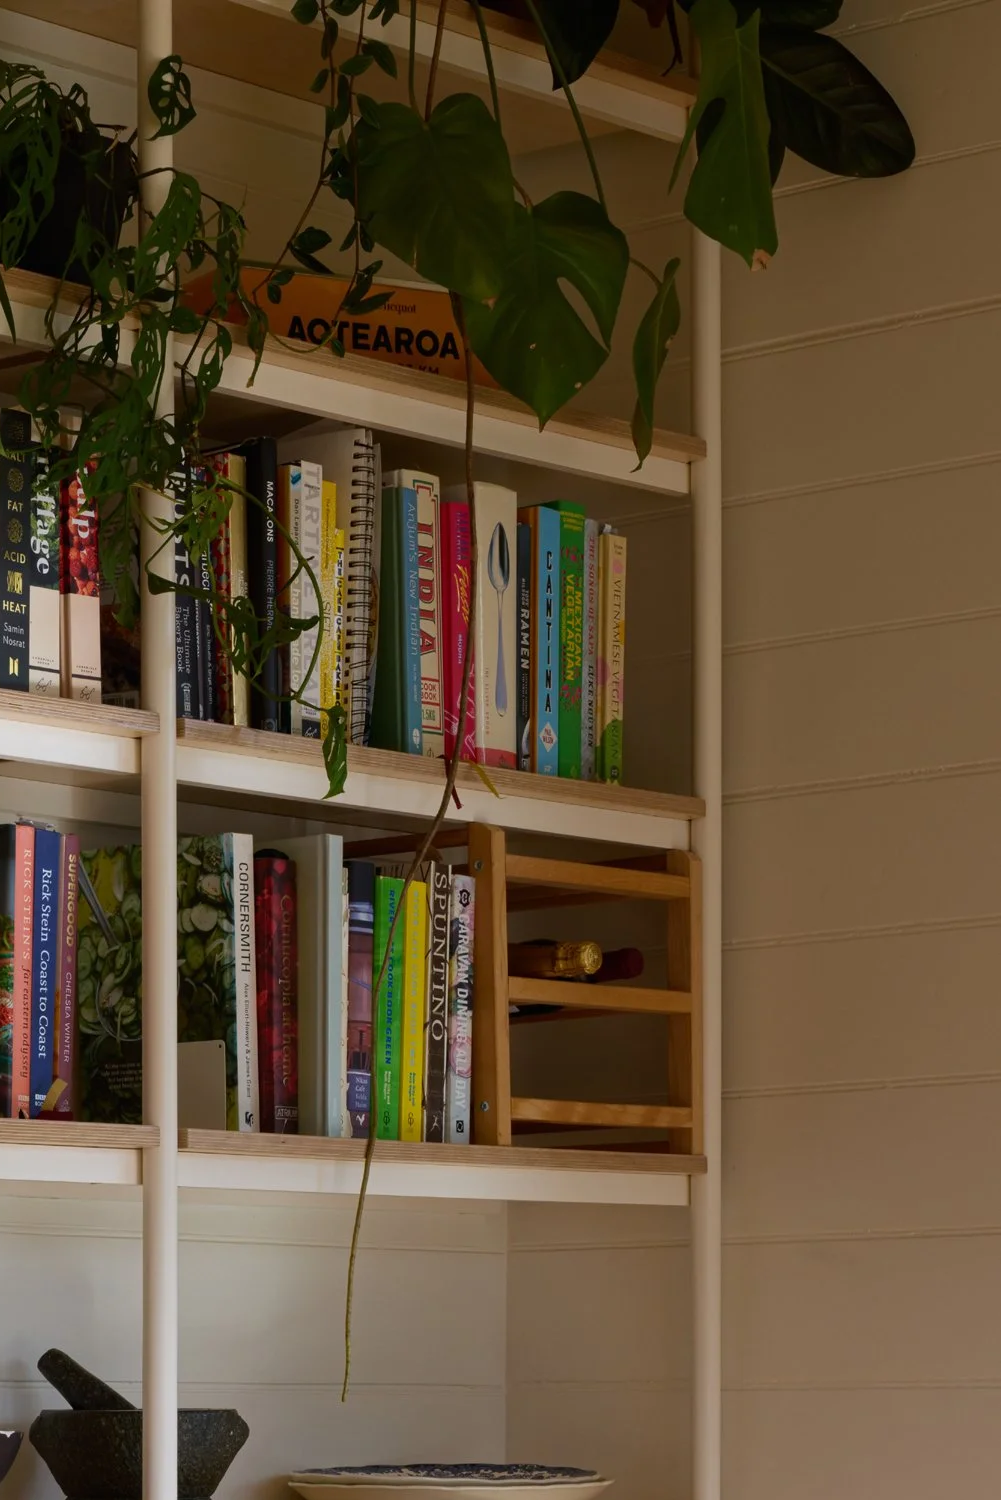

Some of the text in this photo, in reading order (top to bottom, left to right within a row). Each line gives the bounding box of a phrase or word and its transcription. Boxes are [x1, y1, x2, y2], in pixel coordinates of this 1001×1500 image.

[287, 315, 460, 361] AOTEAROA
[7, 500, 24, 512] FAT
[4, 551, 26, 564] ACID
[265, 481, 275, 595] MACAONS PIERRE
[409, 569, 418, 599] New
[418, 521, 437, 657] INDIA
[588, 562, 596, 604] SONGS
[2, 600, 27, 614] HEAT
[3, 622, 24, 635] Samin
[321, 601, 332, 637] SIFT
[409, 605, 419, 656] Indian
[565, 574, 575, 682] VEGETARIAN
[574, 590, 583, 667] MEXICAN
[588, 606, 595, 621] OF
[612, 579, 622, 667] VIETNAMESE
[2, 636, 26, 649] Nosrat
[183, 629, 193, 674] Ultimate
[520, 608, 530, 670] RAMEN
[544, 551, 553, 713] CANTINA
[587, 624, 595, 656] SAPA
[176, 645, 186, 673] Book
[587, 663, 595, 697] LUKE
[586, 700, 594, 749] NGUYEN
[610, 671, 621, 760] VEGETARIAN
[239, 862, 251, 973] CORNERSMITH
[388, 889, 396, 923] RIVER
[20, 848, 32, 1078] RICK STEIN'S far eastern odyssey
[38, 868, 53, 1058] Rick Stein Coast to Coast
[63, 853, 77, 1063] SUPERGOOD CHELSEA WINTER
[431, 871, 448, 1041] SPUNTINO
[279, 894, 295, 1088] Cornucopia at home
[385, 990, 393, 1024] BOOK
[454, 913, 470, 1109] CARAVAN DINING ALL DAY
[384, 1026, 393, 1065] GREEN
